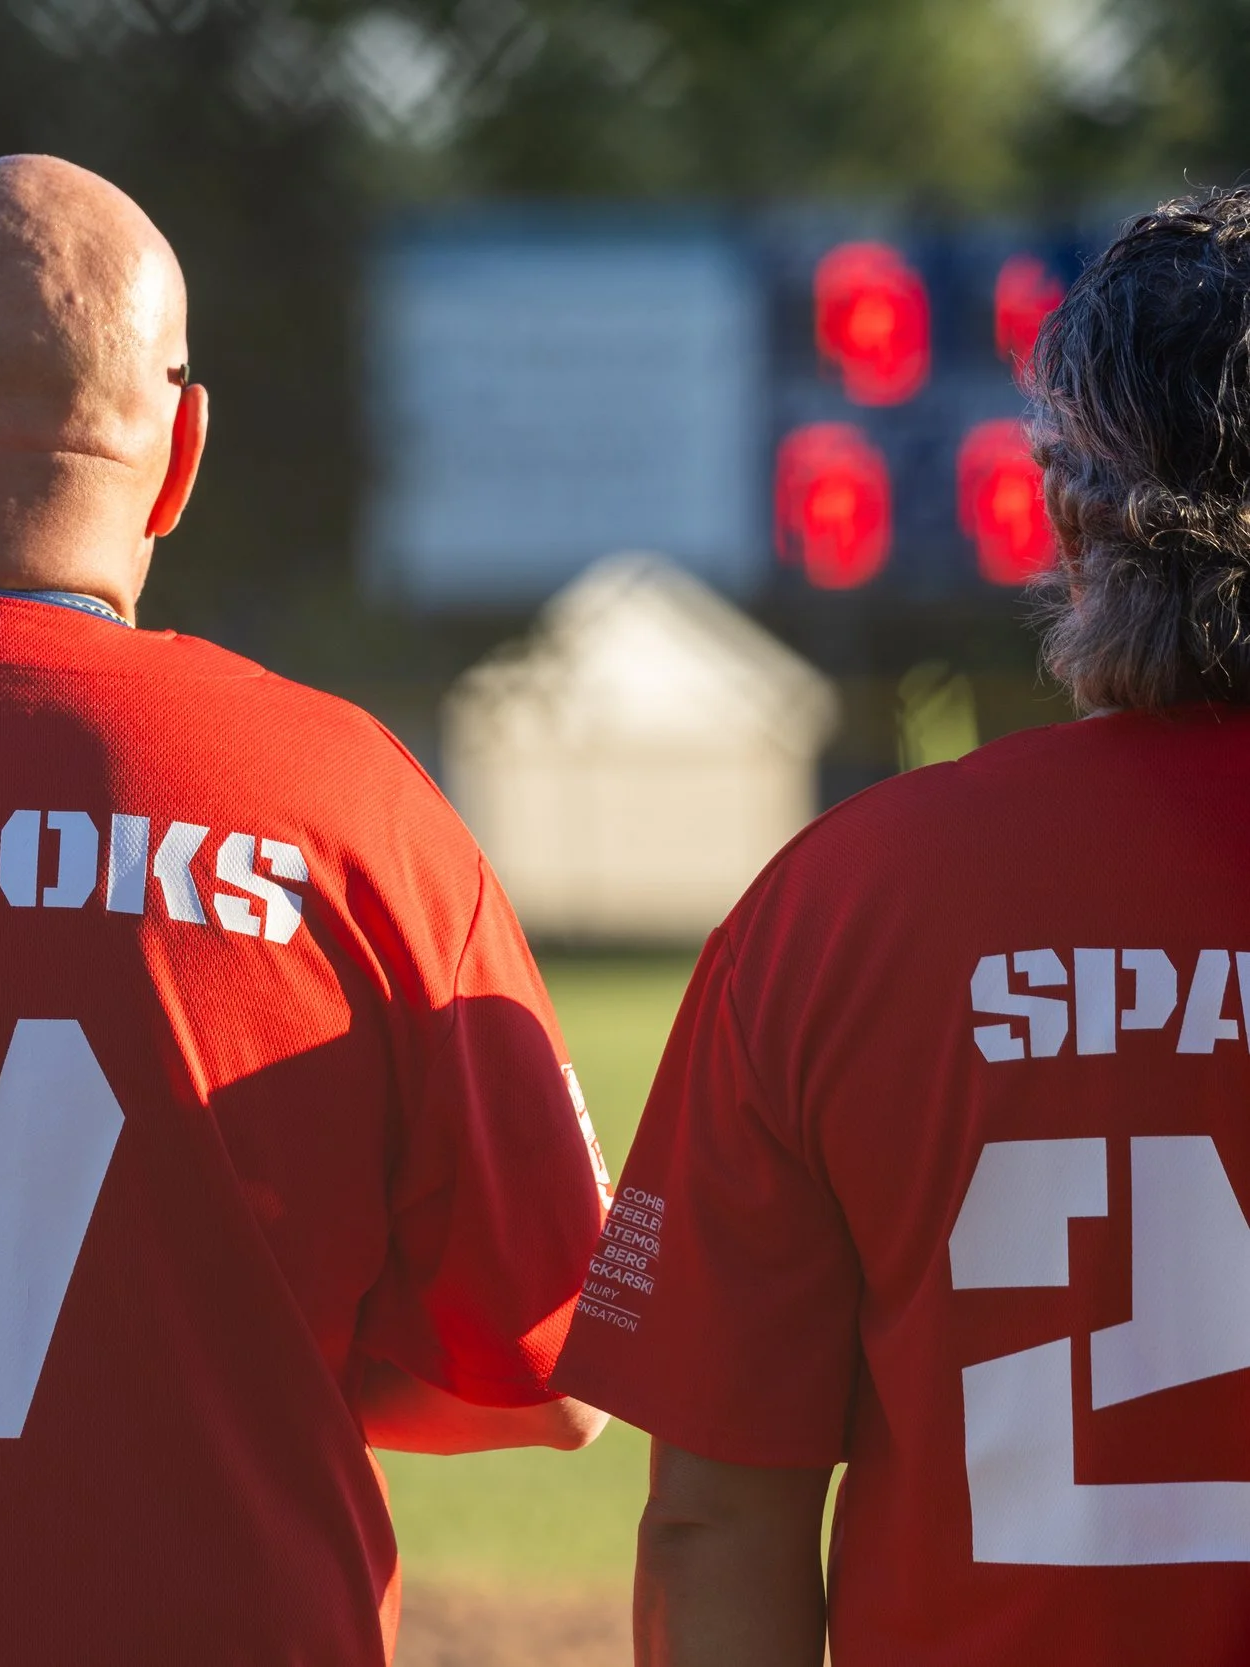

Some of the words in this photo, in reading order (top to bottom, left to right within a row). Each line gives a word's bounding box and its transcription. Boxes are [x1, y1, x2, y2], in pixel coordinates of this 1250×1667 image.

[970, 948, 1250, 1062] SPA
[623, 1187, 665, 1213] COHE
[604, 1244, 648, 1270] BERG
[583, 1278, 621, 1301] JURY
[948, 1135, 1250, 1567] 2
